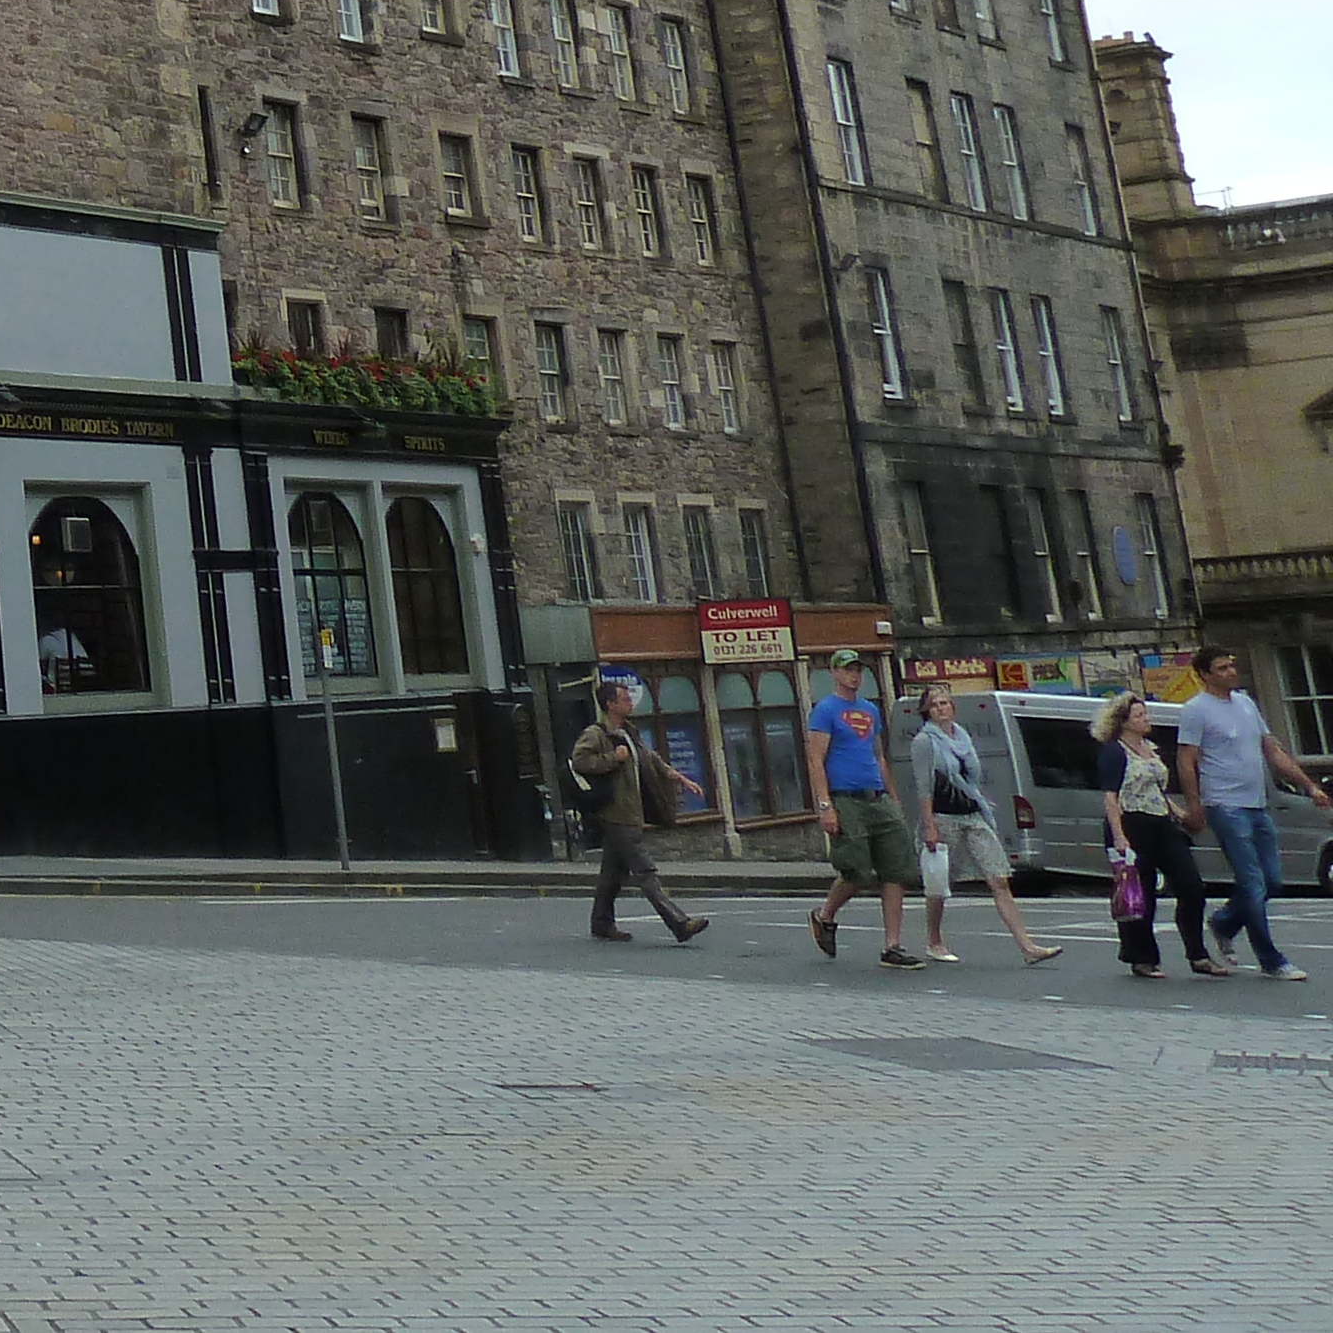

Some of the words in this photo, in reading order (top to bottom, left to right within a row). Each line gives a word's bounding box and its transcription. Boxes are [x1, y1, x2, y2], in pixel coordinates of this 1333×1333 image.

[60, 417, 120, 435] BRODIE'S
[124, 421, 174, 438] TAVERN
[404, 435, 446, 451] SPIRITS
[707, 605, 778, 620] Culverwell
[711, 631, 738, 643] TO
[745, 629, 779, 642] LET
[714, 645, 736, 655] 0131
